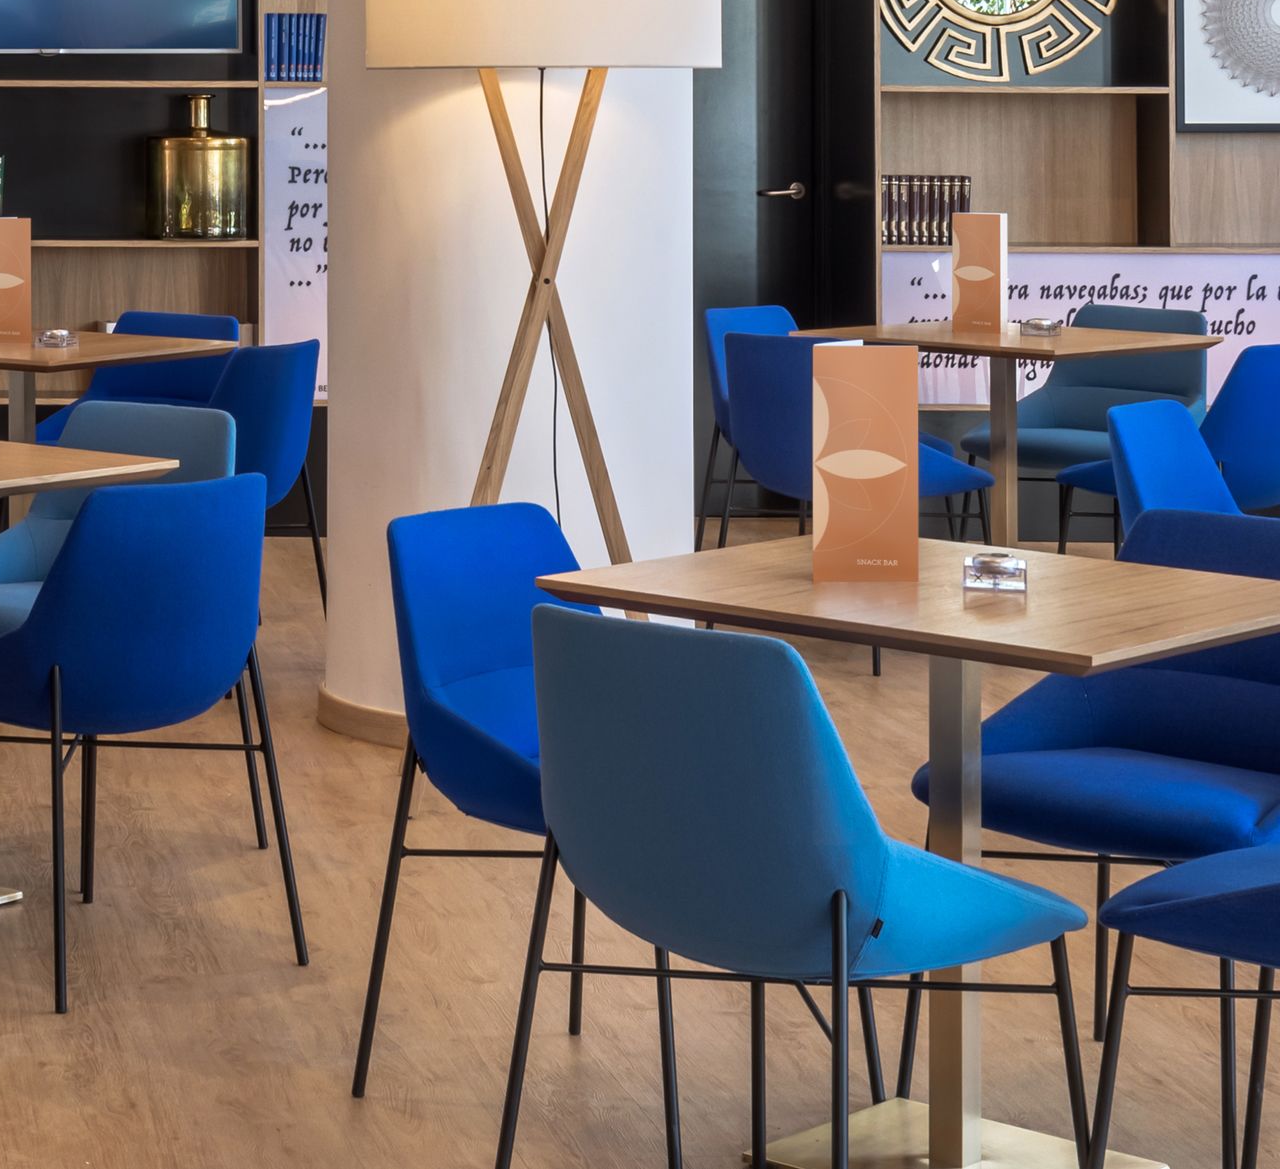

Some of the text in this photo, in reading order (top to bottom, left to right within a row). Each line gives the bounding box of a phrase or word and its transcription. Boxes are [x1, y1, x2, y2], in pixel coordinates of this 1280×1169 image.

[285, 201, 322, 231] por
[290, 238, 312, 252] no
[1040, 274, 1147, 304] navegabas;
[1157, 285, 1193, 310] que
[1200, 283, 1238, 314] por
[1247, 274, 1267, 301] la
[1210, 308, 1255, 335] ucho
